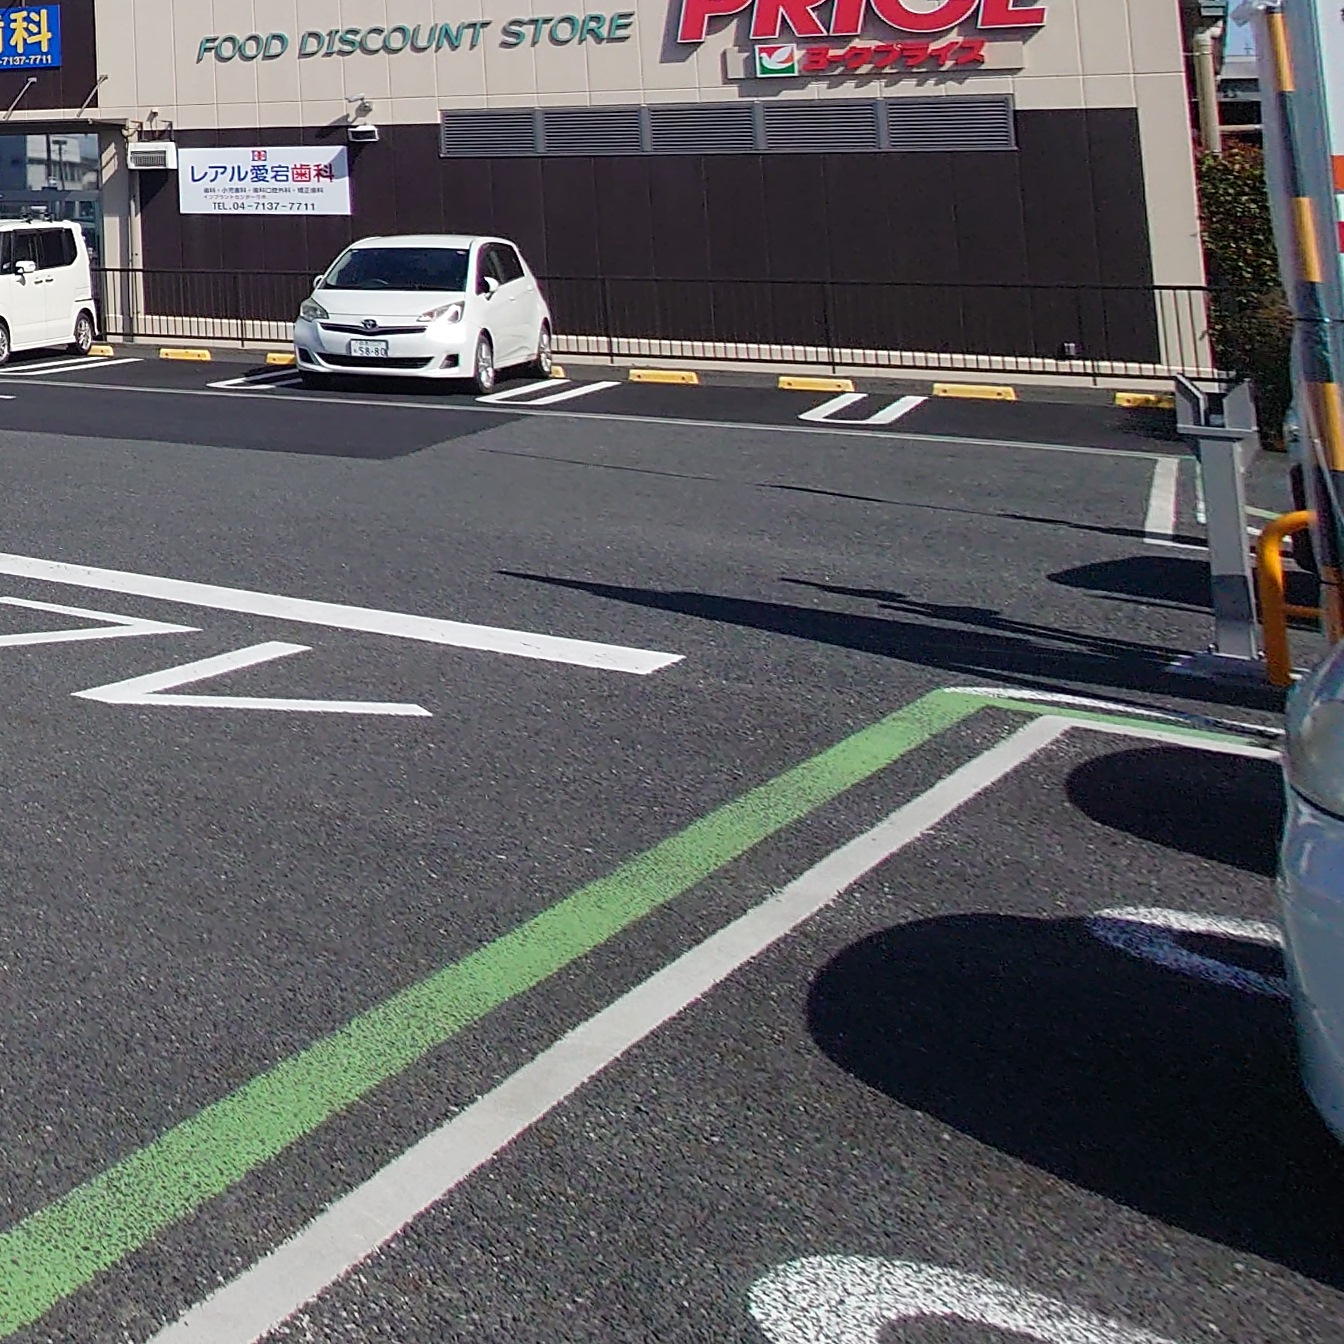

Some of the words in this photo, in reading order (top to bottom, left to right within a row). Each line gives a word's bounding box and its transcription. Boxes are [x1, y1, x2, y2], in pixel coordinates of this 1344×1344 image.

[196, 32, 289, 64] FOOD
[298, 19, 492, 59] DISCOUNT
[499, 11, 635, 48] STORE
[801, 39, 986, 71] ヨークプライス
[190, 164, 335, 183] レアル愛宕歯科
[212, 201, 316, 211] TEL.04-7137-7711
